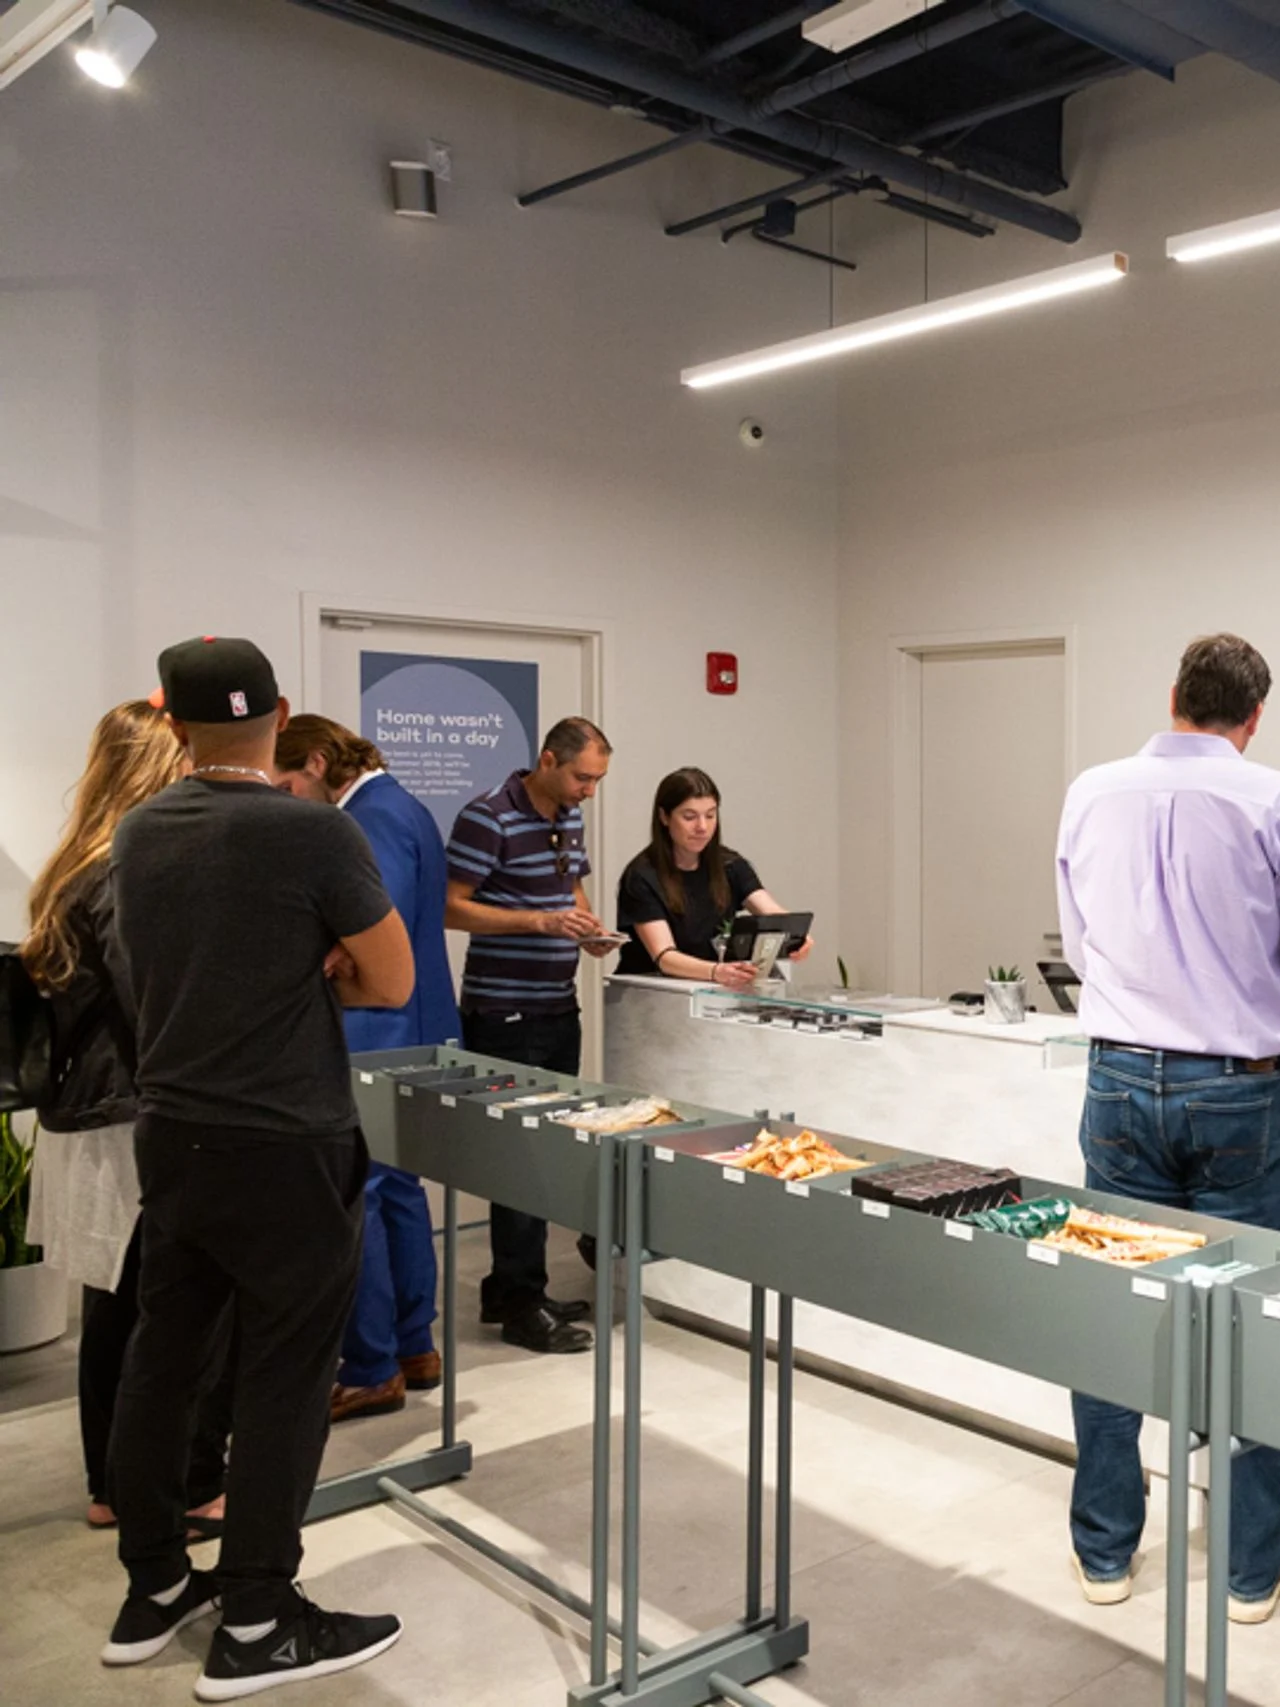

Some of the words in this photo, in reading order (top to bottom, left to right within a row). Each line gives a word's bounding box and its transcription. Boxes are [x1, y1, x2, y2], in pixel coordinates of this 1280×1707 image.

[376, 708, 436, 726] Home
[440, 712, 504, 729] wasn't
[376, 726, 423, 744] built
[426, 727, 444, 744] in
[447, 732, 461, 745] a
[464, 730, 500, 749] day
